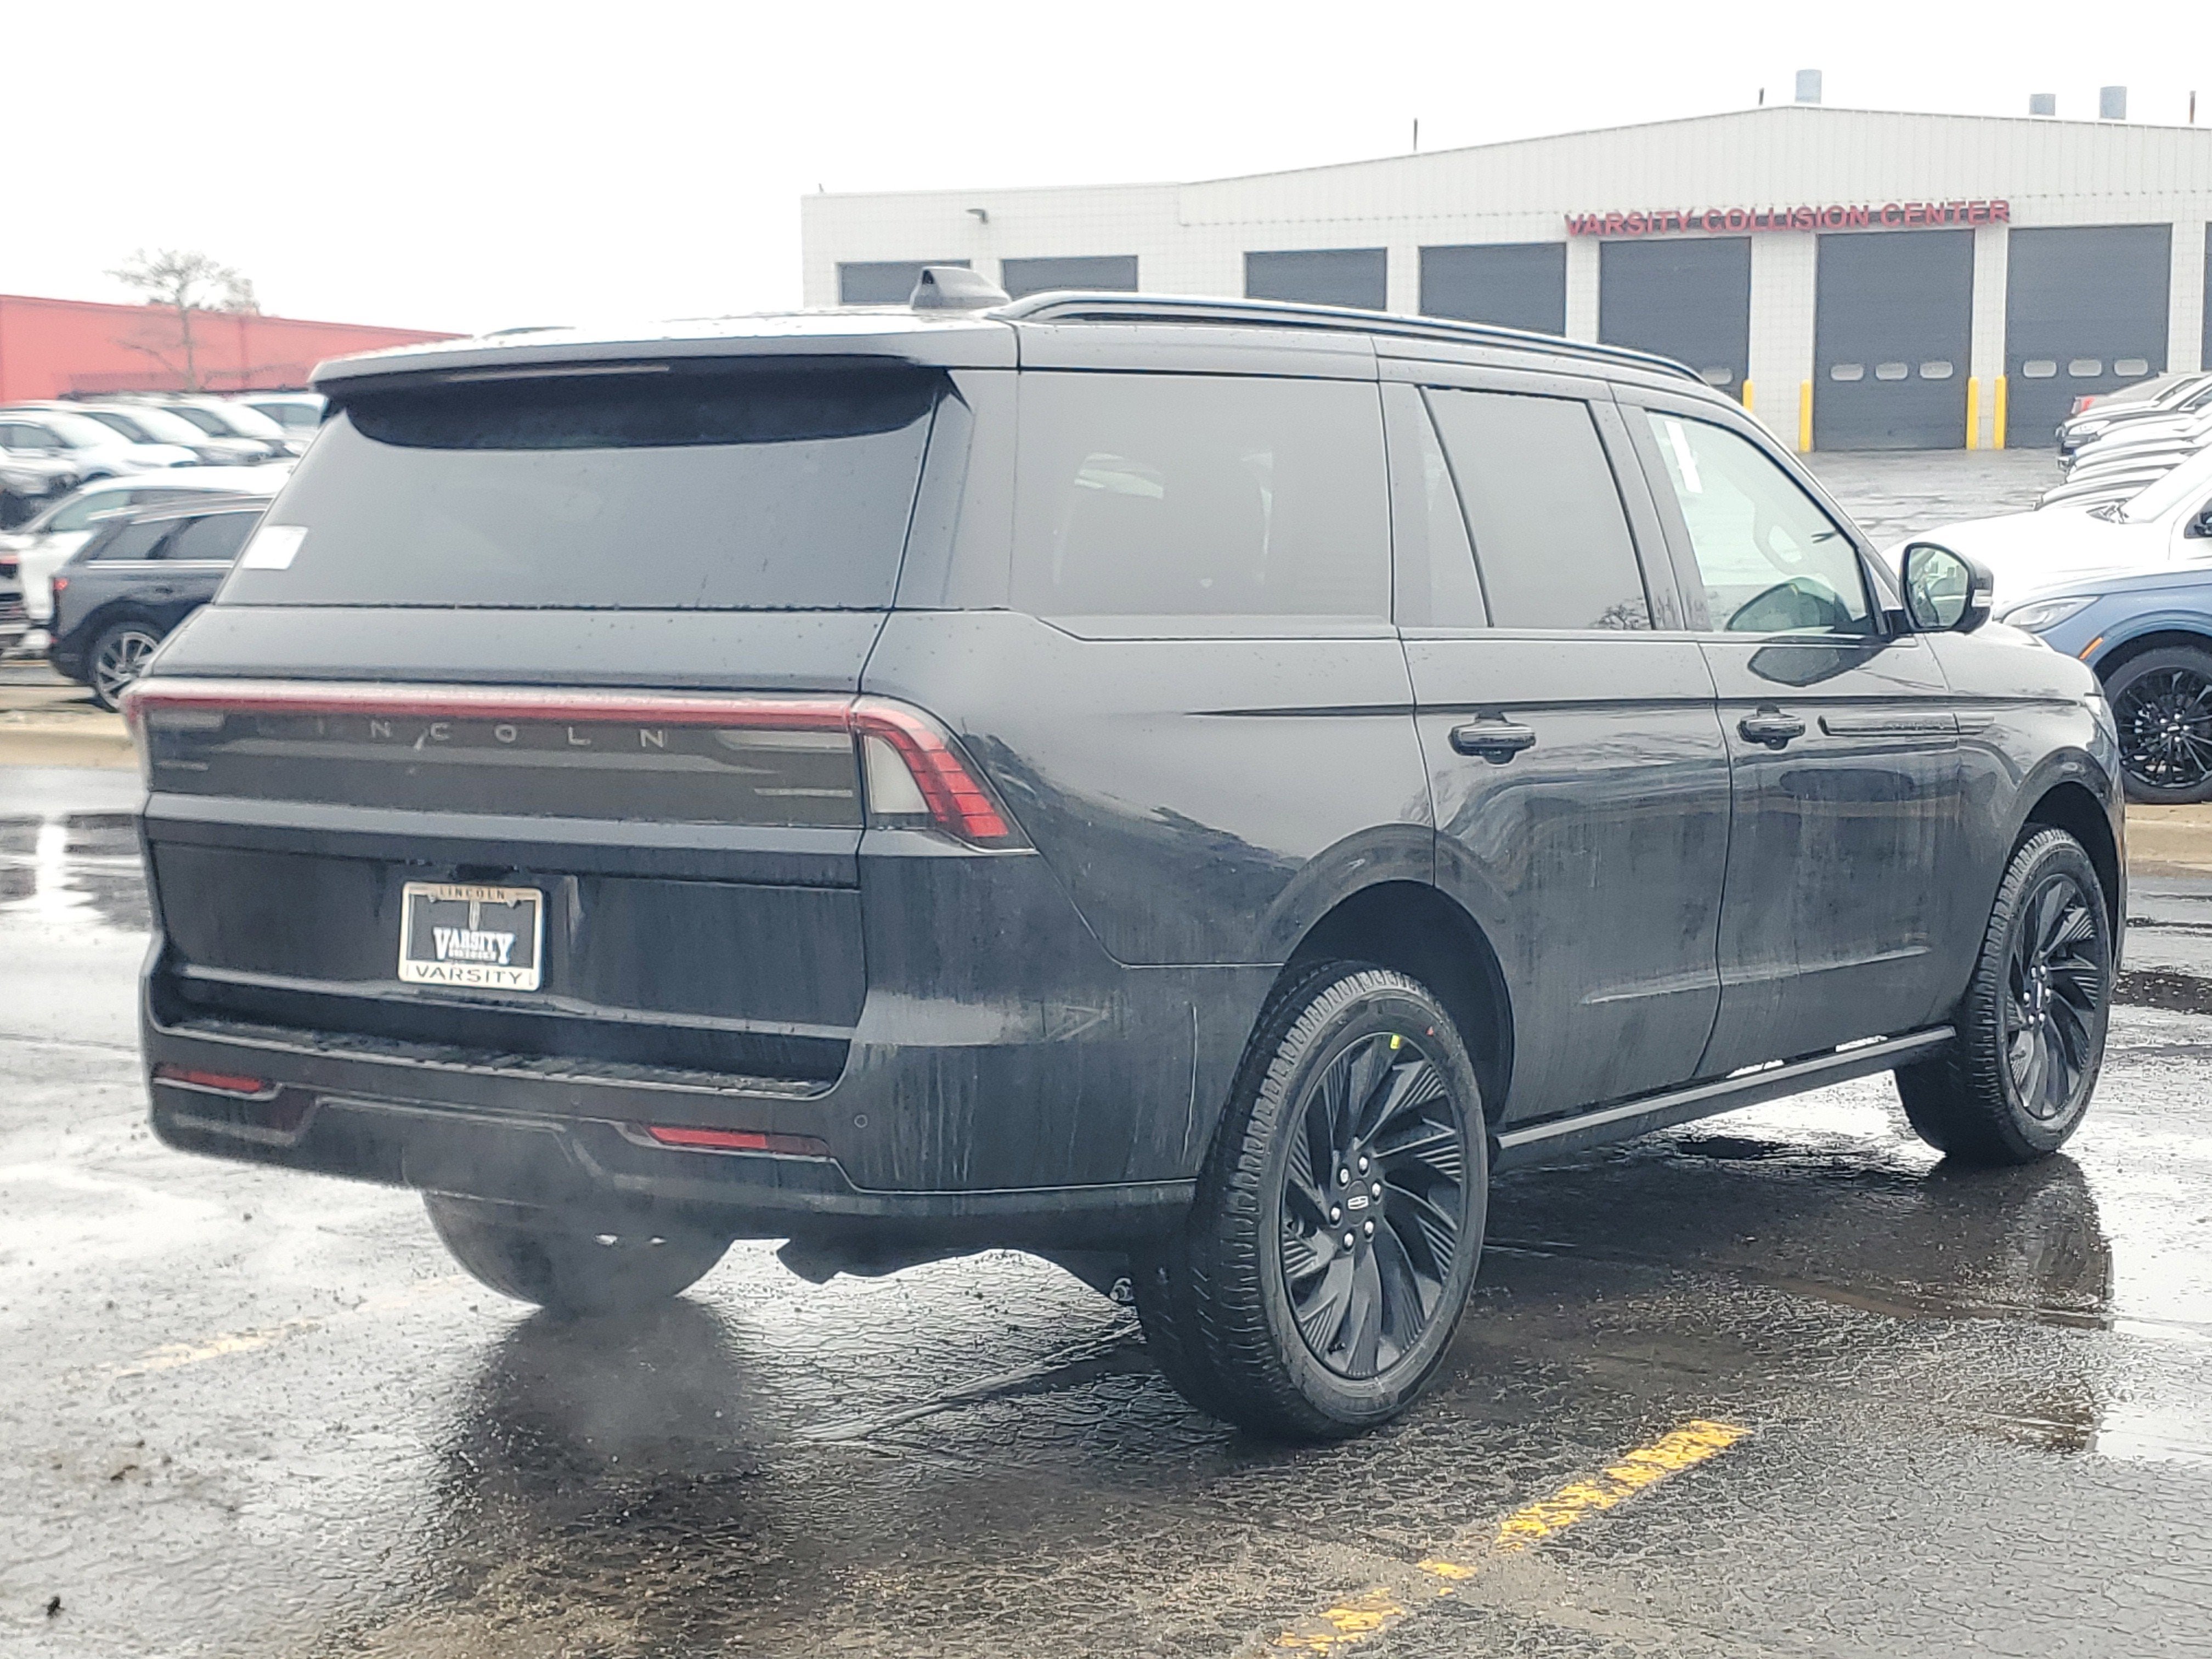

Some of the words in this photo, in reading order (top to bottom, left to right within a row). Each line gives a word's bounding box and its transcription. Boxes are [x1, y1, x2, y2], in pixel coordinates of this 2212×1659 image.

[1564, 208, 1692, 236] VARSITY
[1701, 206, 1869, 233] COLLISION
[1880, 200, 2010, 228] CENTER
[439, 887, 505, 899] LINCOLN
[433, 927, 515, 964] VARSITY
[416, 965, 522, 984] VARSITY
